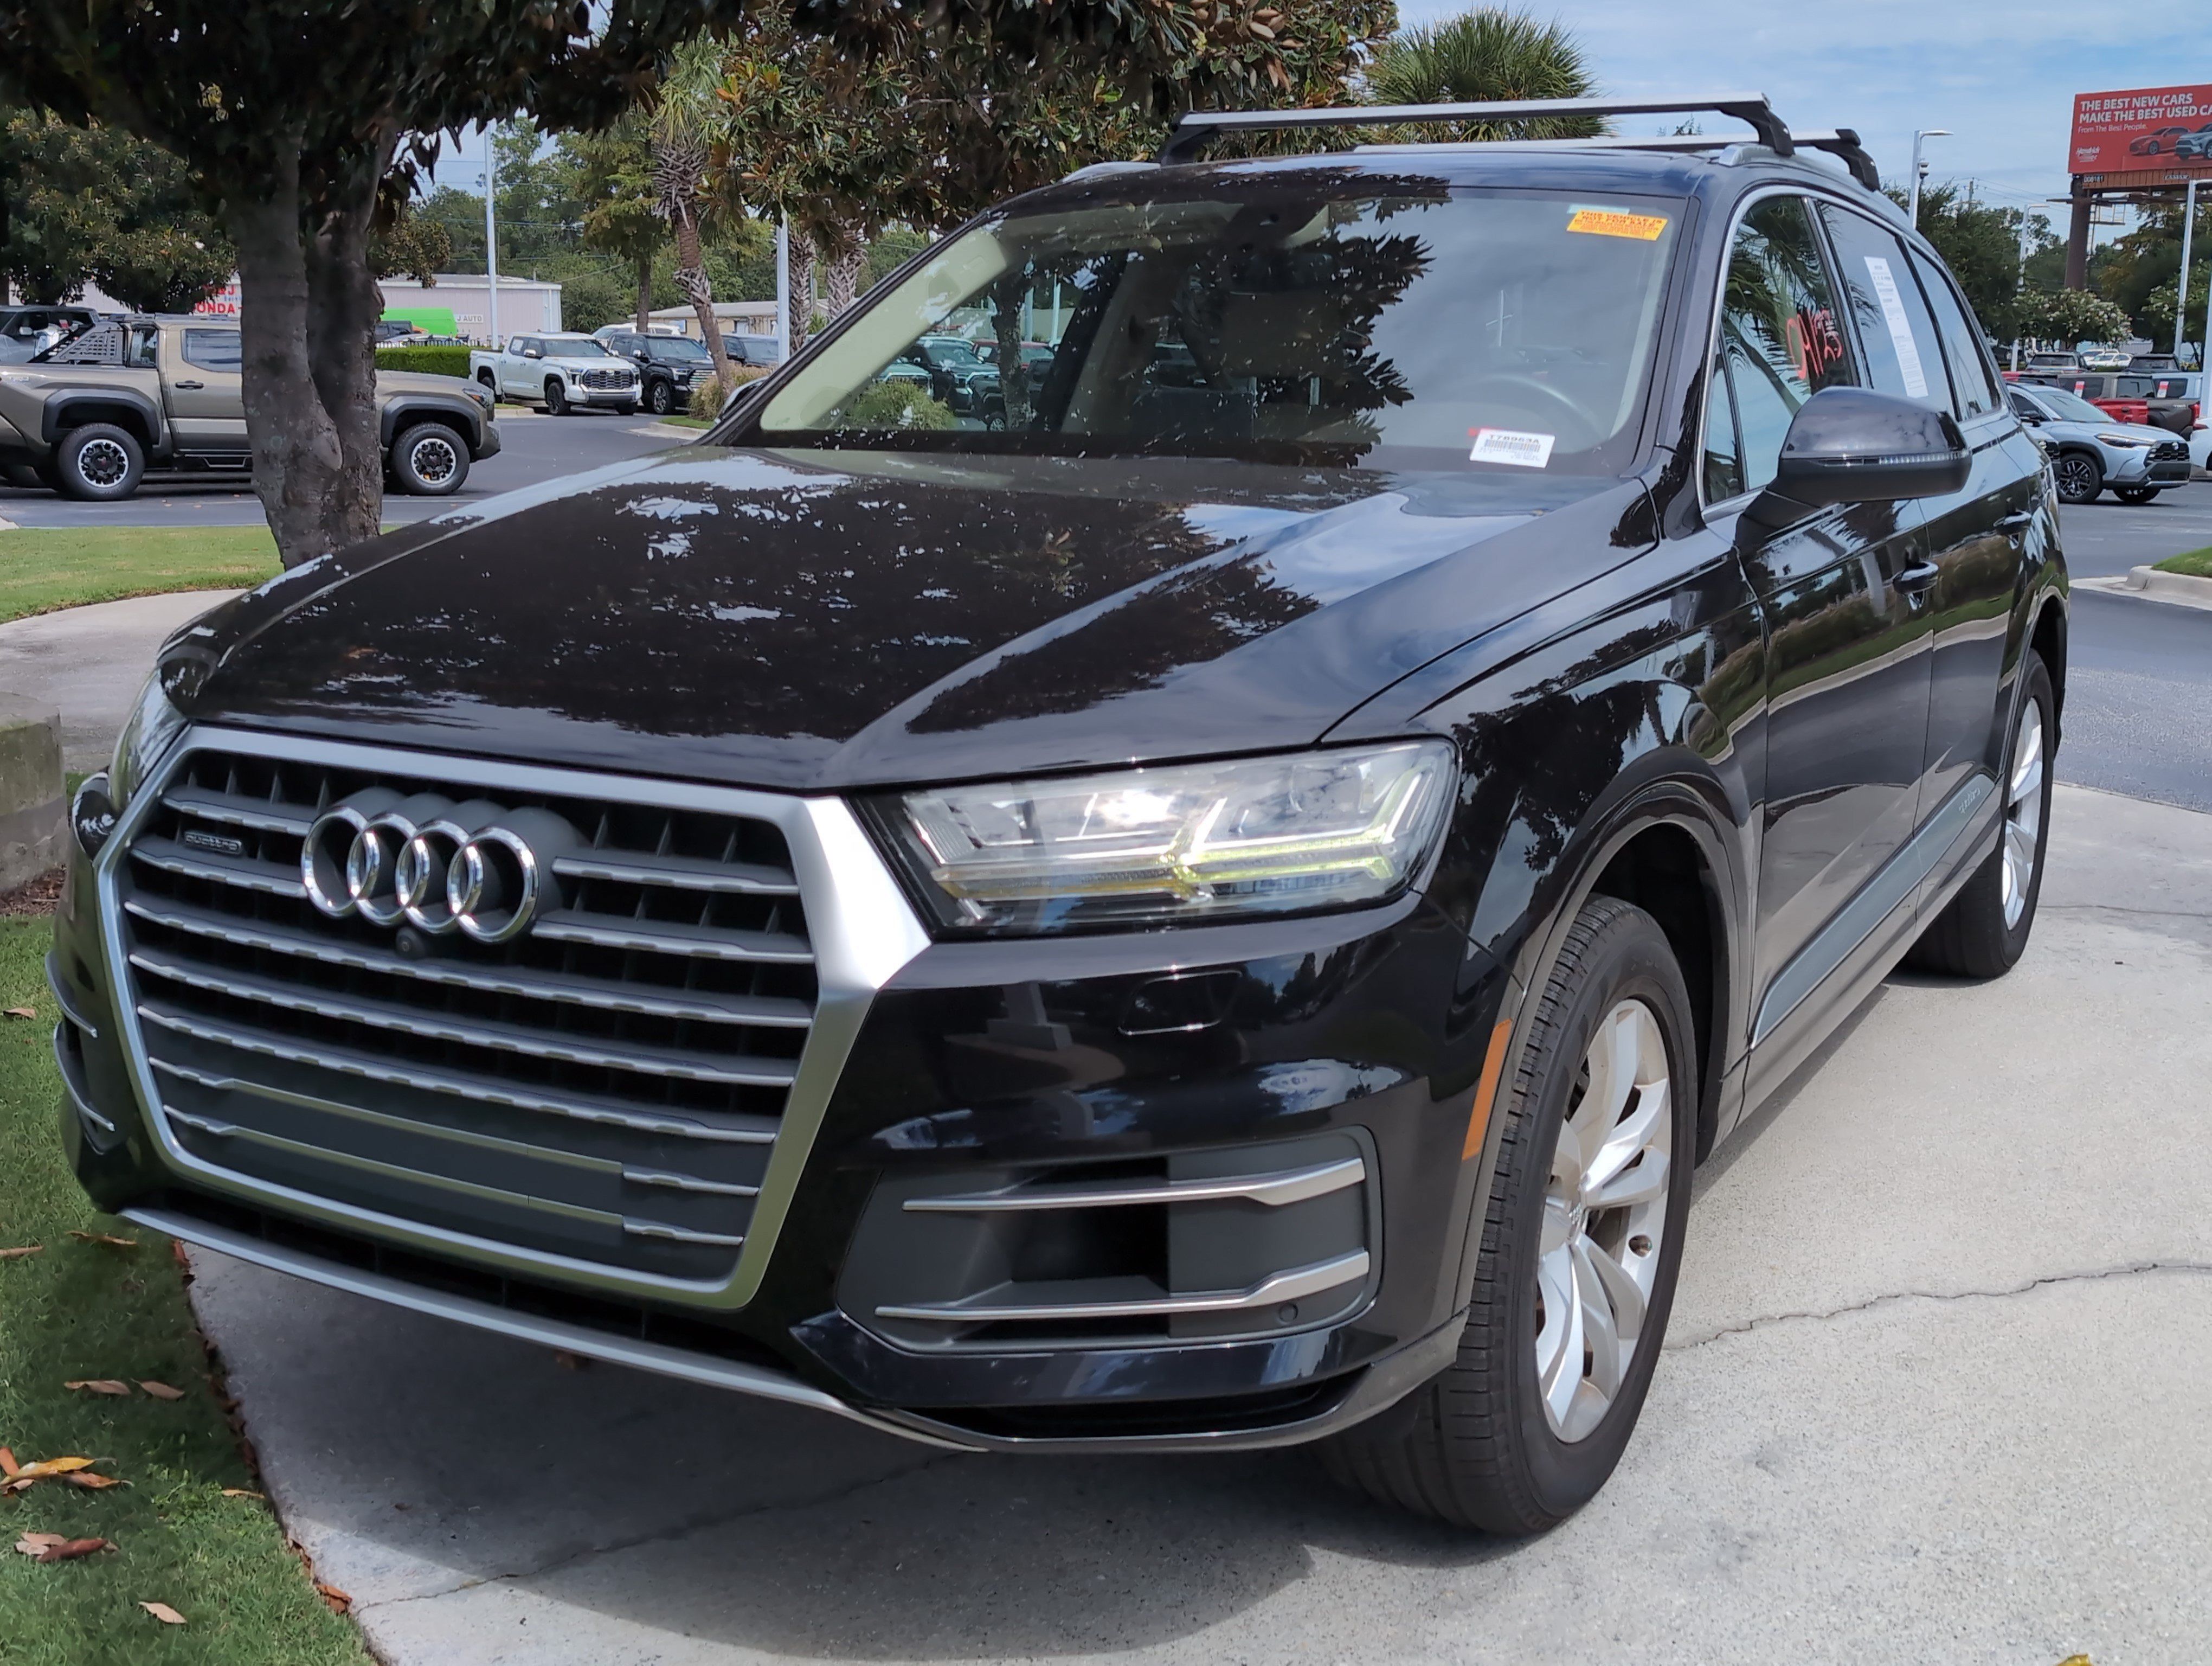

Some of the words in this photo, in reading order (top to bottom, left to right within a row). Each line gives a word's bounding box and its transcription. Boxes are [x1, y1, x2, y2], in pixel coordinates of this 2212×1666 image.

[2080, 100, 2101, 112] THE
[2104, 98, 2130, 110] BEST
[2132, 95, 2160, 108] NEW
[2162, 93, 2193, 106] CARS
[2079, 111, 2112, 124] MAKE
[2114, 110, 2135, 122] THE
[2137, 107, 2164, 120] BEST
[2166, 105, 2197, 118] USED
